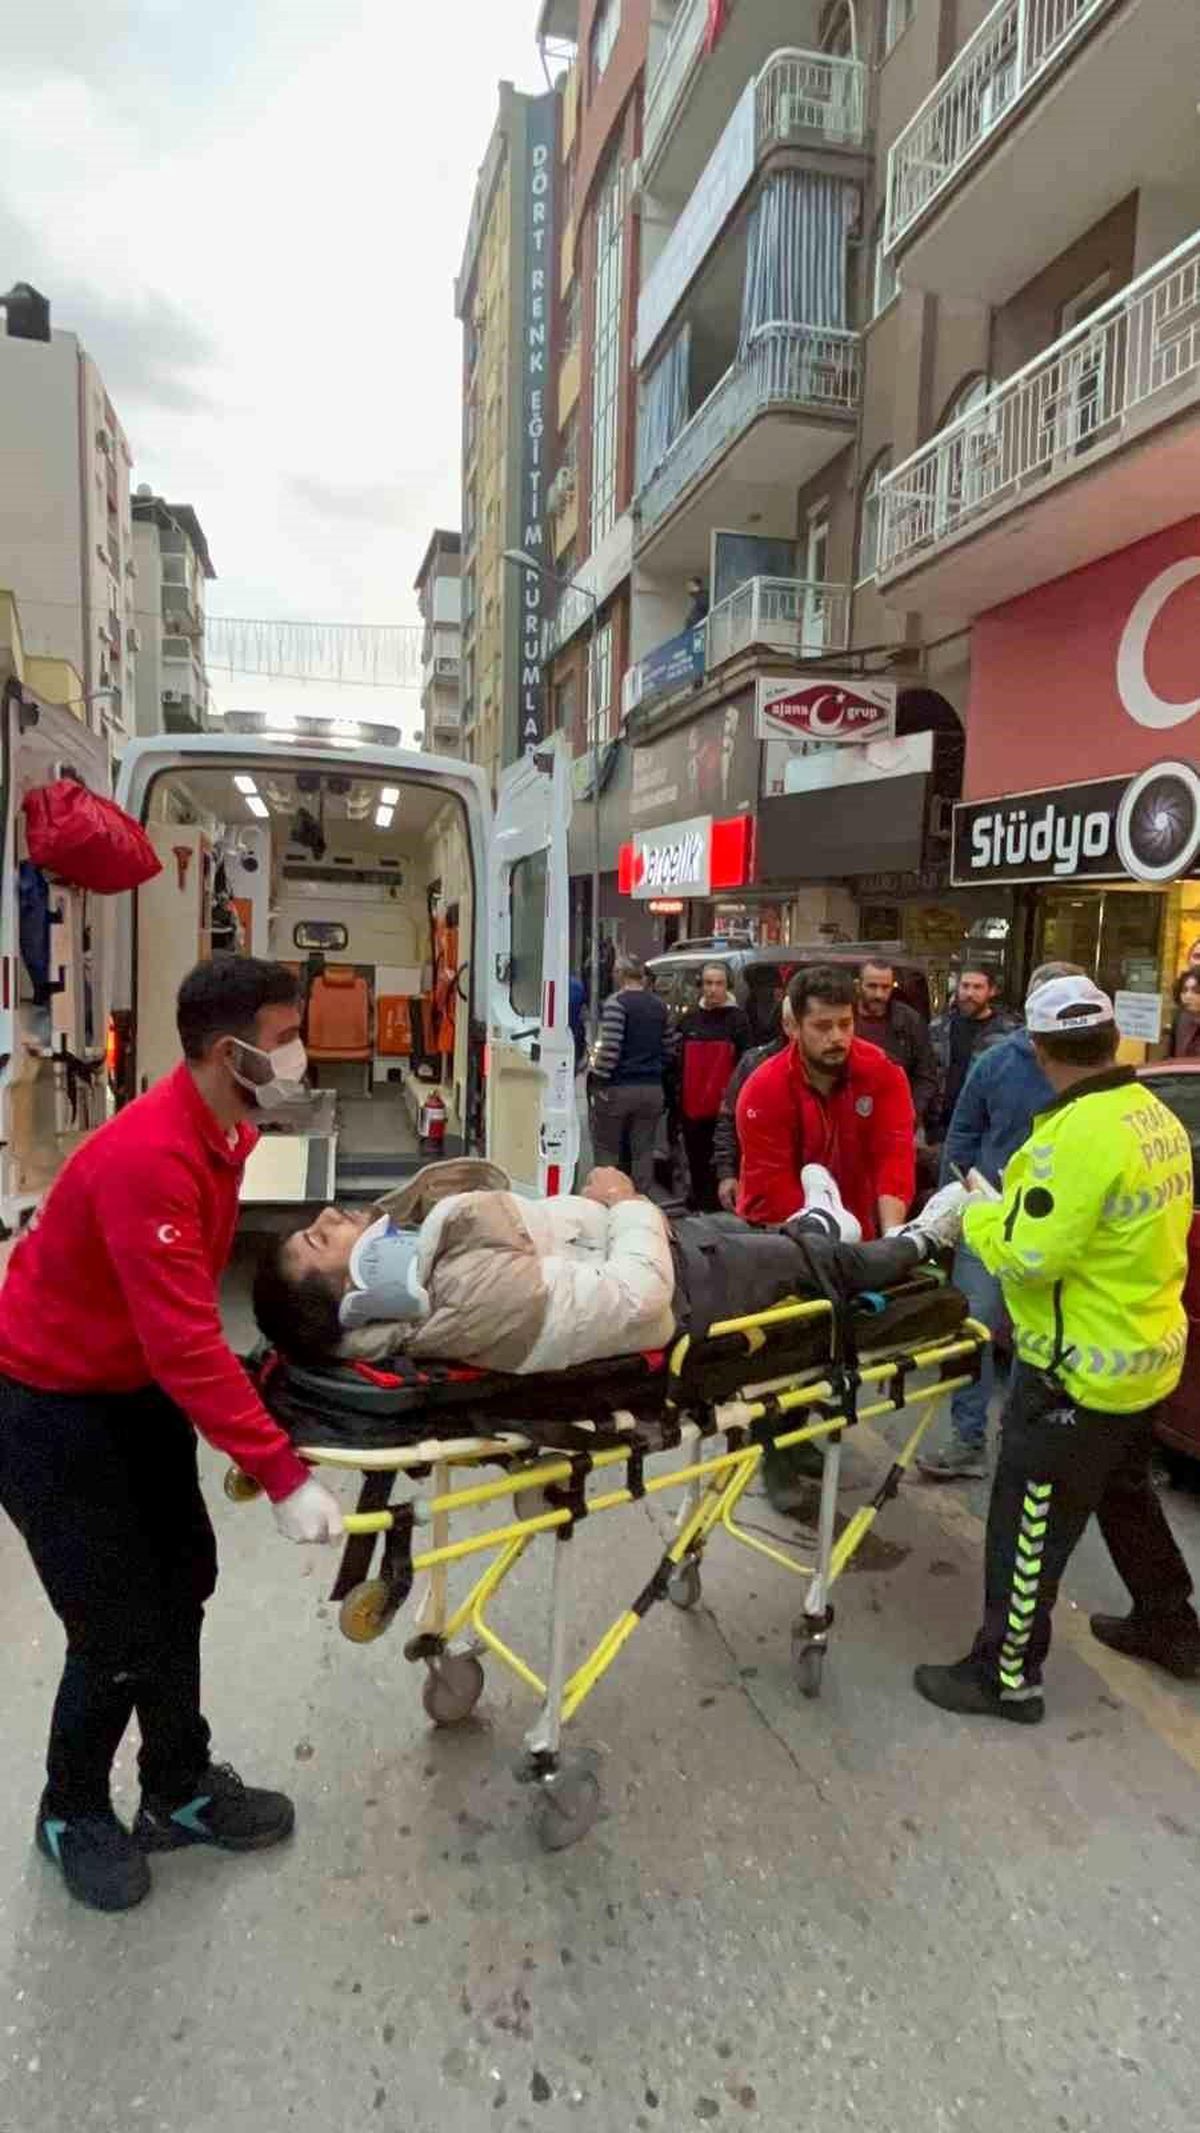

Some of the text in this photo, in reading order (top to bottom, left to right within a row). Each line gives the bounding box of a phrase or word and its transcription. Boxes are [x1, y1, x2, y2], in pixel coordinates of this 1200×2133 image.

[530, 269, 544, 375] RENK
[847, 706, 878, 721] grup
[971, 804, 1110, 875] Stüdyo
